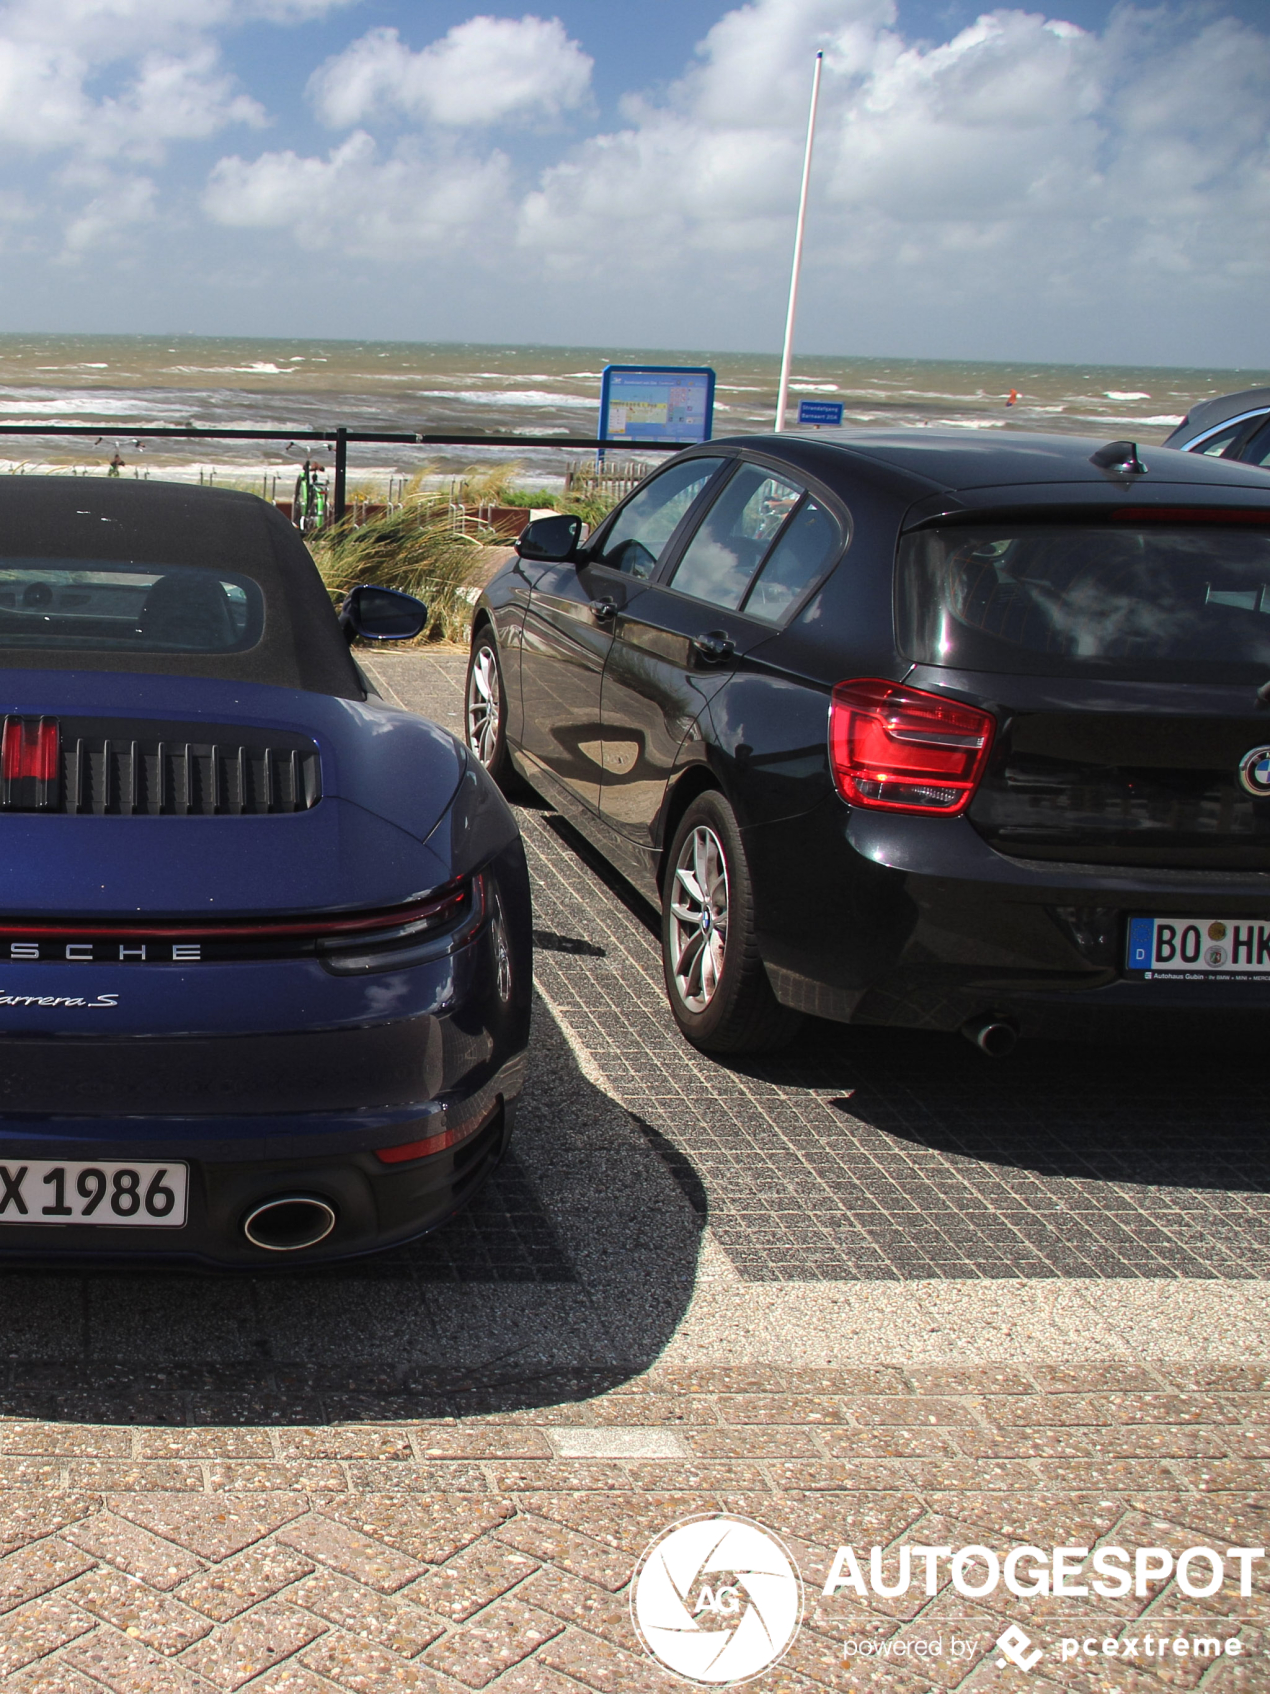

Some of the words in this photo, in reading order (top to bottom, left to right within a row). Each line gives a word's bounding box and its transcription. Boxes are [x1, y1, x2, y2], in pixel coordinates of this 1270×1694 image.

[1135, 948, 1145, 960] D
[1155, 924, 1201, 963] BO
[88, 994, 120, 1007] S
[41, 1167, 176, 1218] 1986
